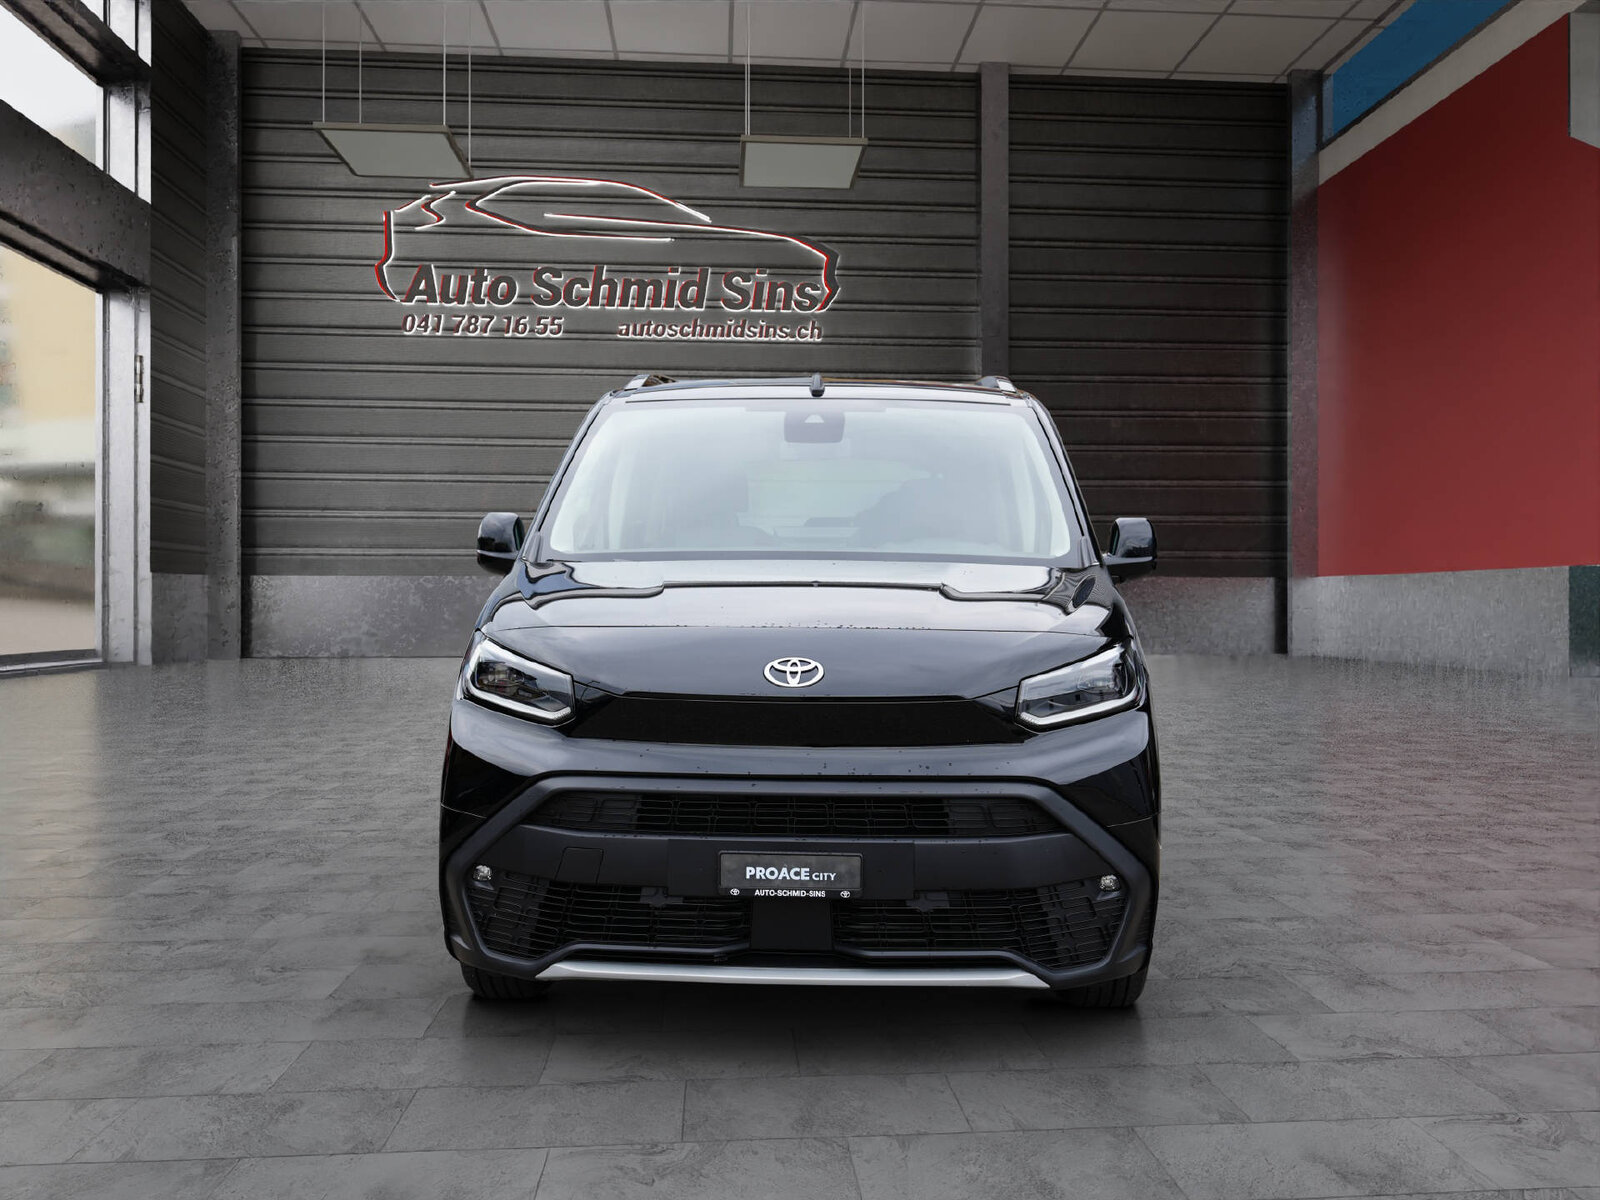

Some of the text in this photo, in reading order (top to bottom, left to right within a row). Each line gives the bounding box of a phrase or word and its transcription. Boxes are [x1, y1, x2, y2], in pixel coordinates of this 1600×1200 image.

[401, 264, 822, 313] Auto Schmid Sins
[401, 314, 564, 337] 041 787 16 55
[616, 318, 823, 342] autoschmidsins.ch
[745, 866, 837, 881] PROACE CITY
[754, 889, 826, 898] AUTO-SCHMID-SINS
